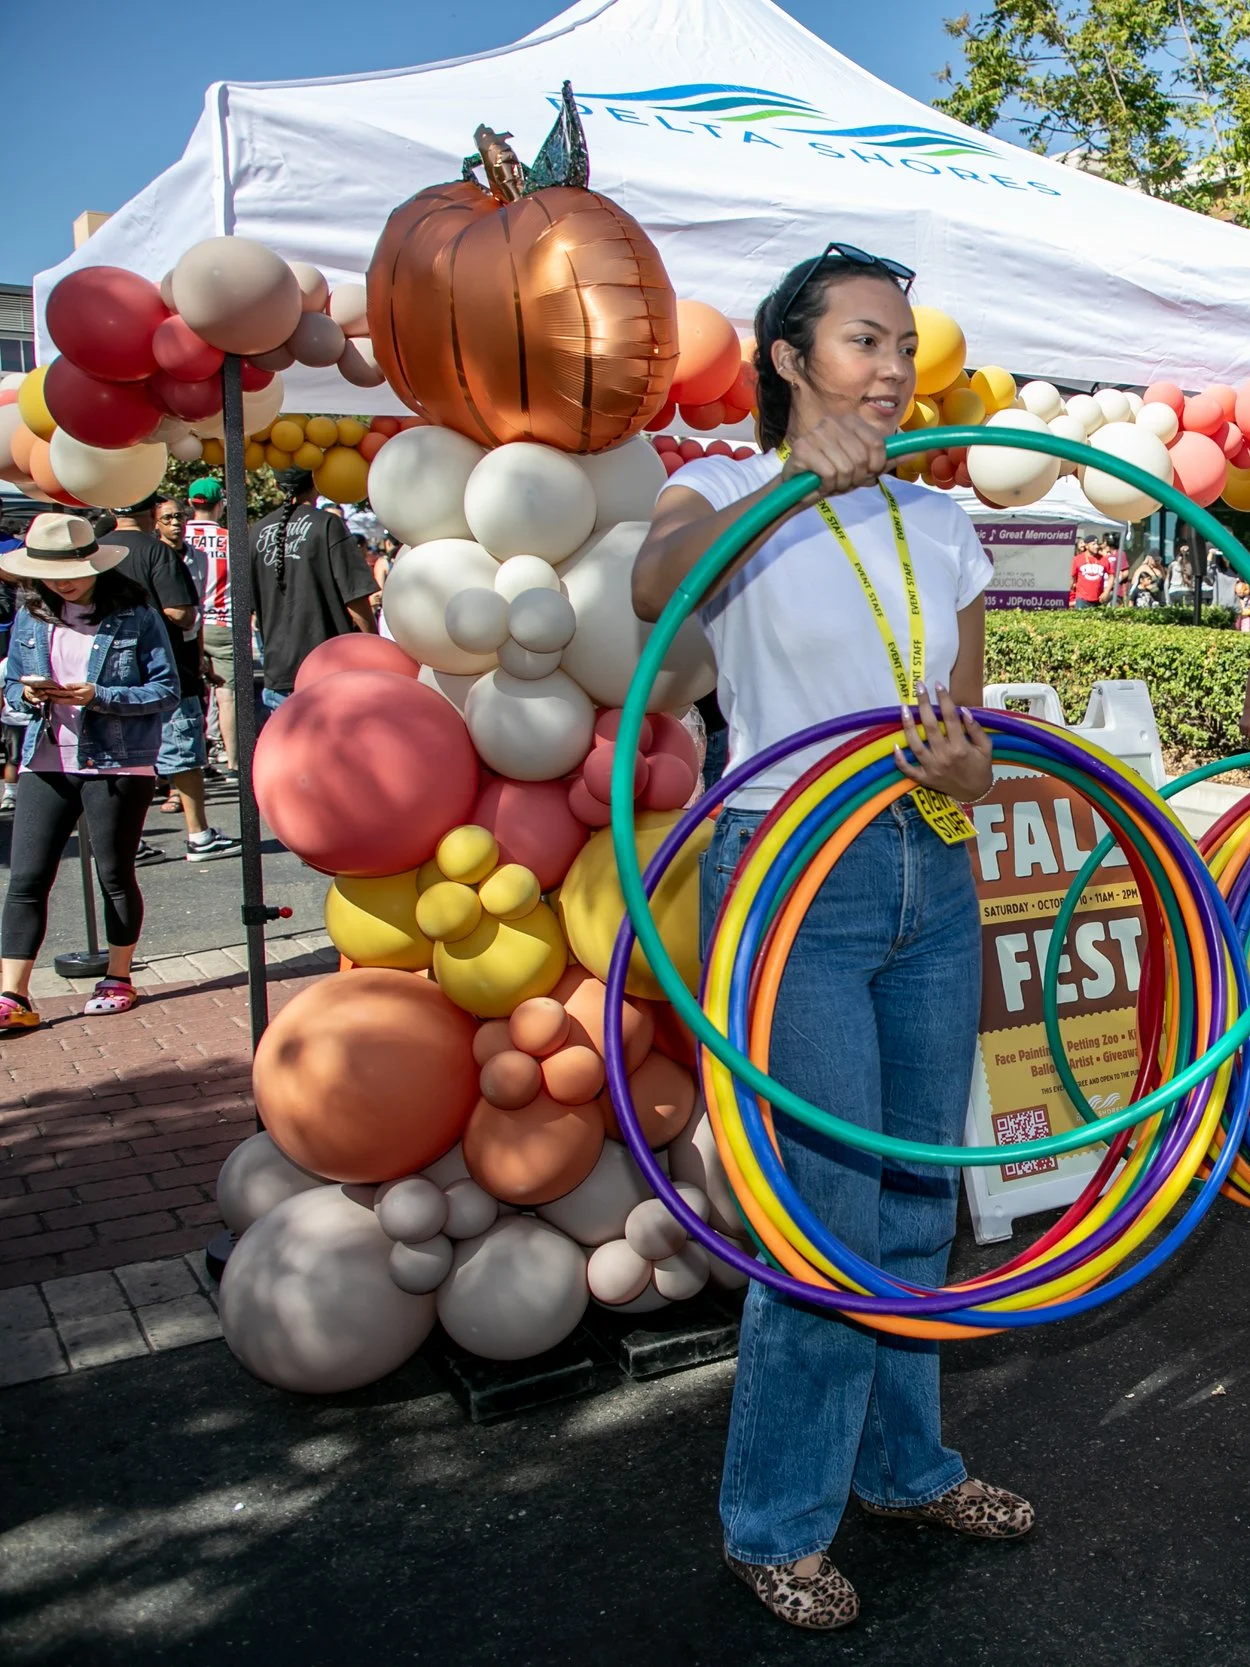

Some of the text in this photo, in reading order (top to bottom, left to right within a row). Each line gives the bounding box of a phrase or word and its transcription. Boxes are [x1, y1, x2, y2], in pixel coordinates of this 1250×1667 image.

[807, 141, 1062, 196] SHORES
[827, 516, 847, 540] STAFF
[999, 529, 1023, 540] Great
[1025, 529, 1073, 540] Memories!
[855, 562, 884, 618] EVENT STAFF
[902, 562, 920, 615] EVENT STAFF
[1006, 596, 1065, 606] JDProDJ.com
[912, 639, 923, 666] STAFF
[888, 641, 910, 698] EVENT STAFF
[916, 790, 952, 815] EVEN
[933, 811, 970, 838] STAFF
[984, 902, 1029, 918] SATURDAY
[1037, 898, 1064, 911] OCTO
[1094, 891, 1115, 903] 11AM
[1122, 888, 1139, 900] 2PM
[995, 917, 1142, 1012] FEST
[995, 1052, 1016, 1066] Face
[1018, 1046, 1052, 1061] Paintin
[1067, 1036, 1100, 1053] Petting
[1102, 1033, 1119, 1046] Zoo
[1031, 1062, 1056, 1077] Ballo
[1069, 1055, 1094, 1070] Artist
[1041, 1086, 1052, 1095] THIS
[1089, 1078, 1099, 1086] AND
[1100, 1075, 1113, 1083] OPEN
[1113, 1073, 1120, 1081] TO
